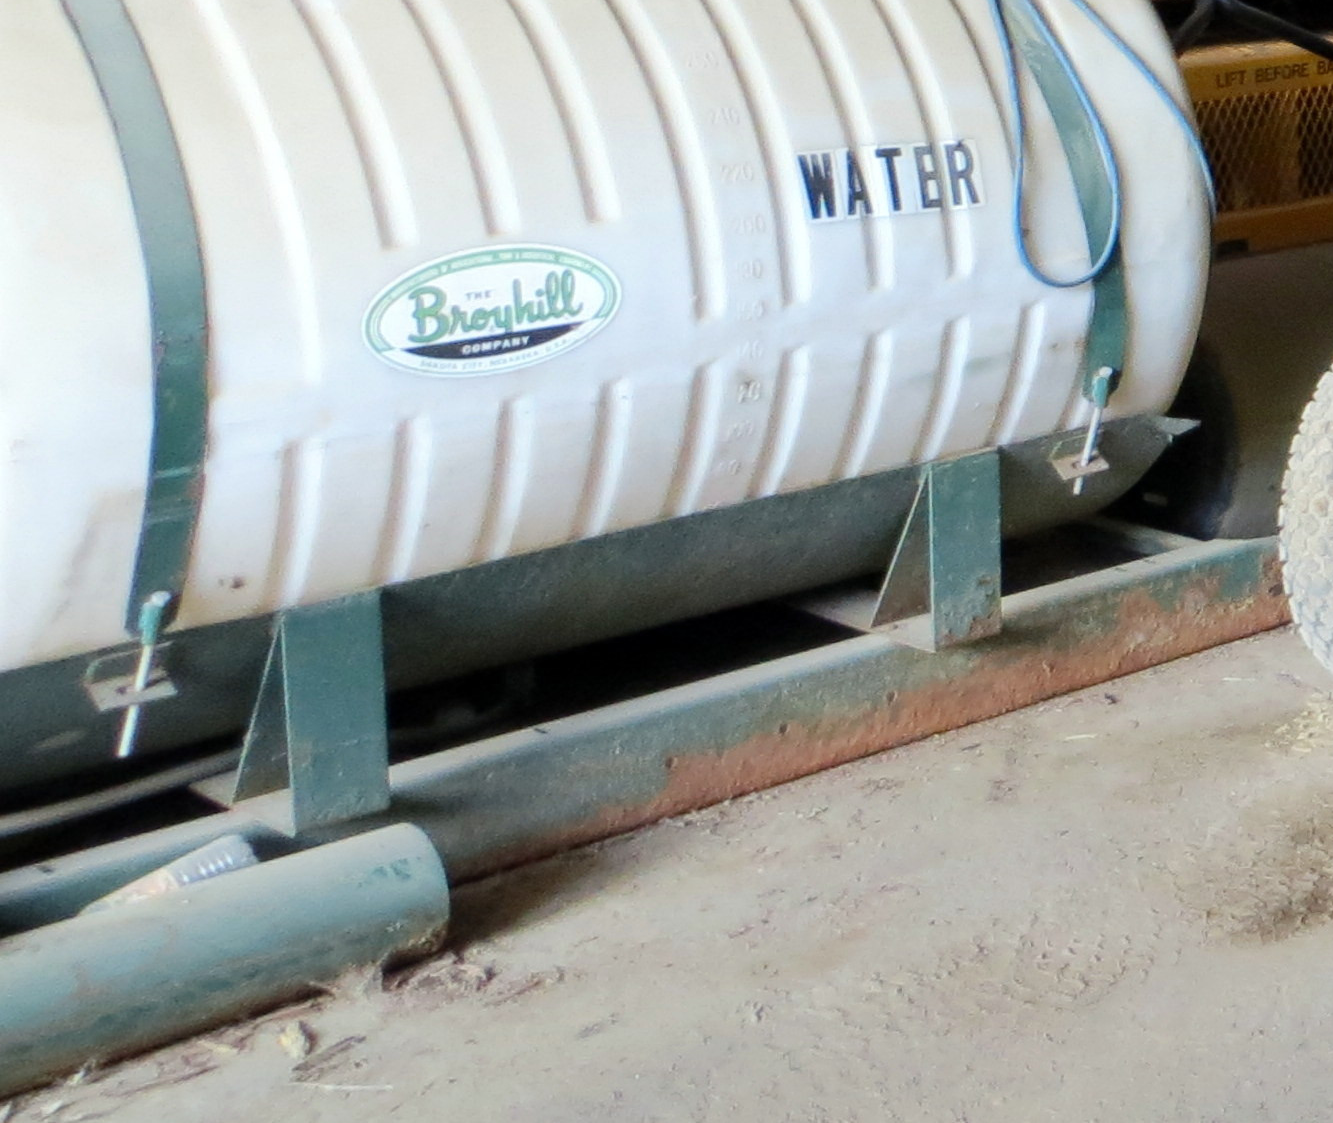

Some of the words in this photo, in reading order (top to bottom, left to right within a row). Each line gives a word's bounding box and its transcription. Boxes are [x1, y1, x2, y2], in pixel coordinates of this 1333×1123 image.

[1215, 69, 1247, 89] LIFT
[1254, 62, 1310, 84] BEFORE
[797, 142, 981, 220] WATER
[408, 269, 584, 343] Broyhill
[465, 289, 493, 301] THE
[461, 334, 531, 356] COMPANY
